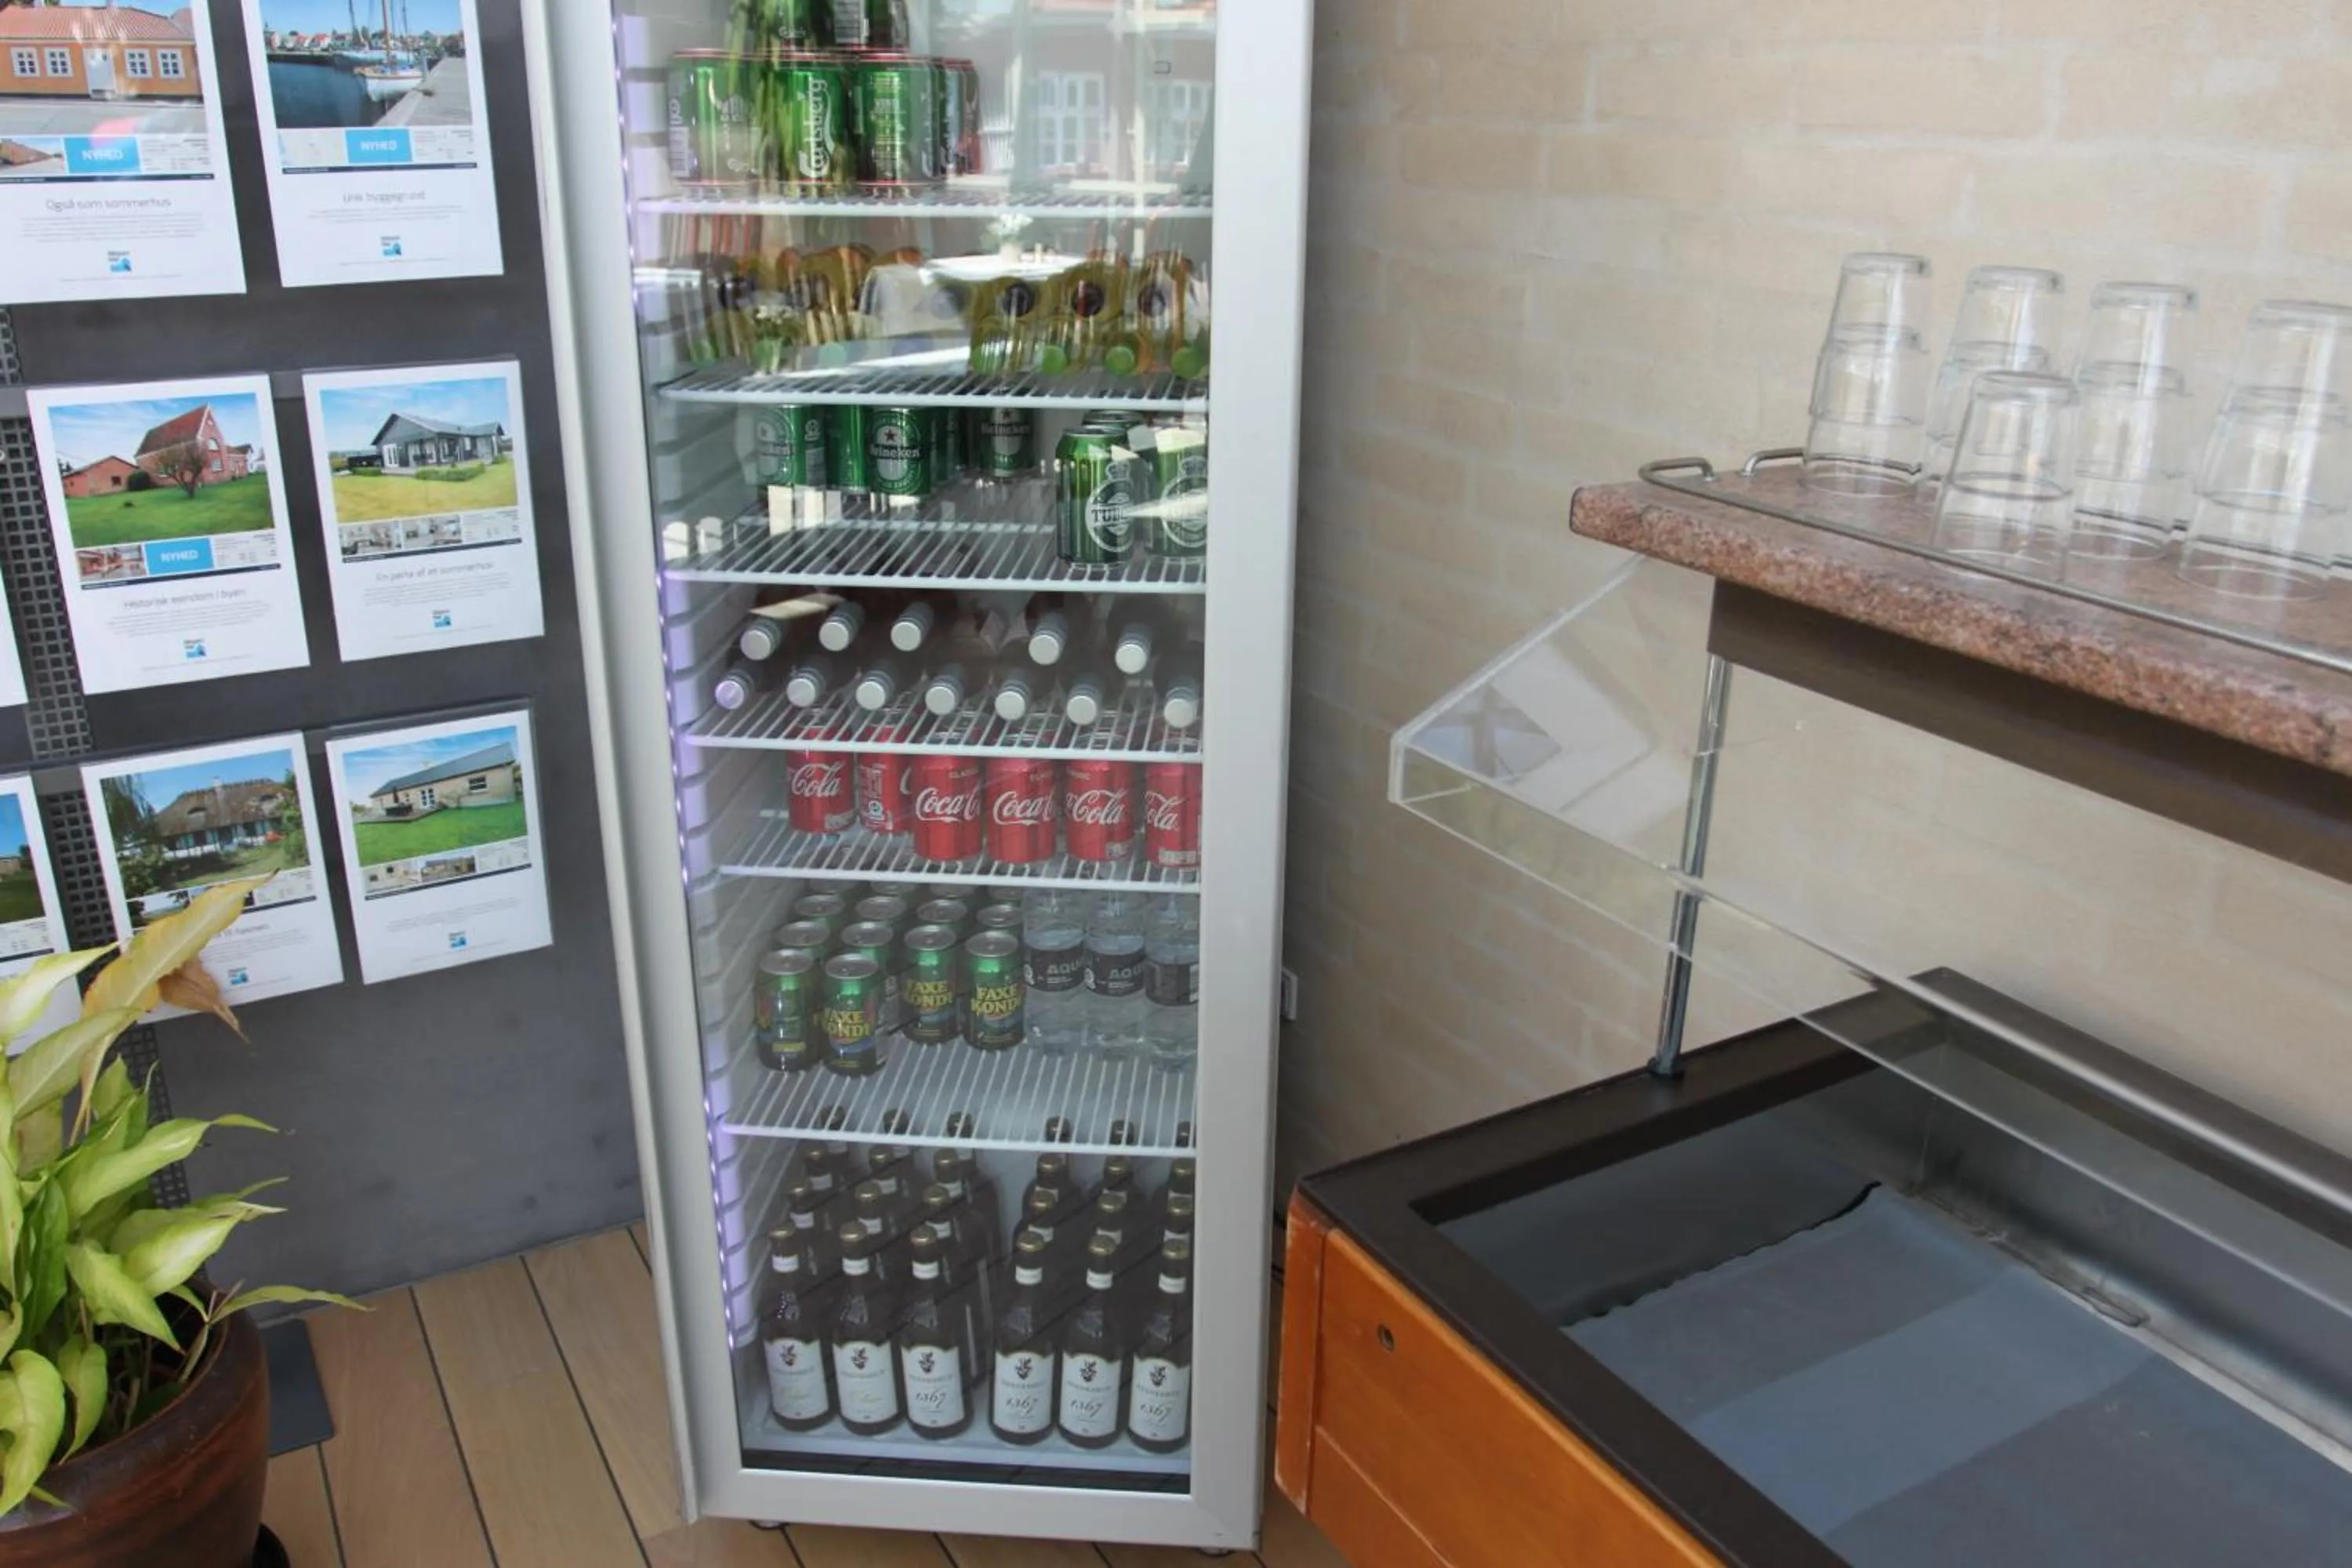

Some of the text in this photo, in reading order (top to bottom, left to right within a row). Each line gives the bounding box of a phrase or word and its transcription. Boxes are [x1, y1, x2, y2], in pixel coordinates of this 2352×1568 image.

[798, 78, 835, 178] Carlsberg
[359, 140, 398, 152] NYHED
[81, 148, 125, 162] NYHED
[159, 549, 199, 563] NYHED
[976, 982, 1018, 1000] FAXE
